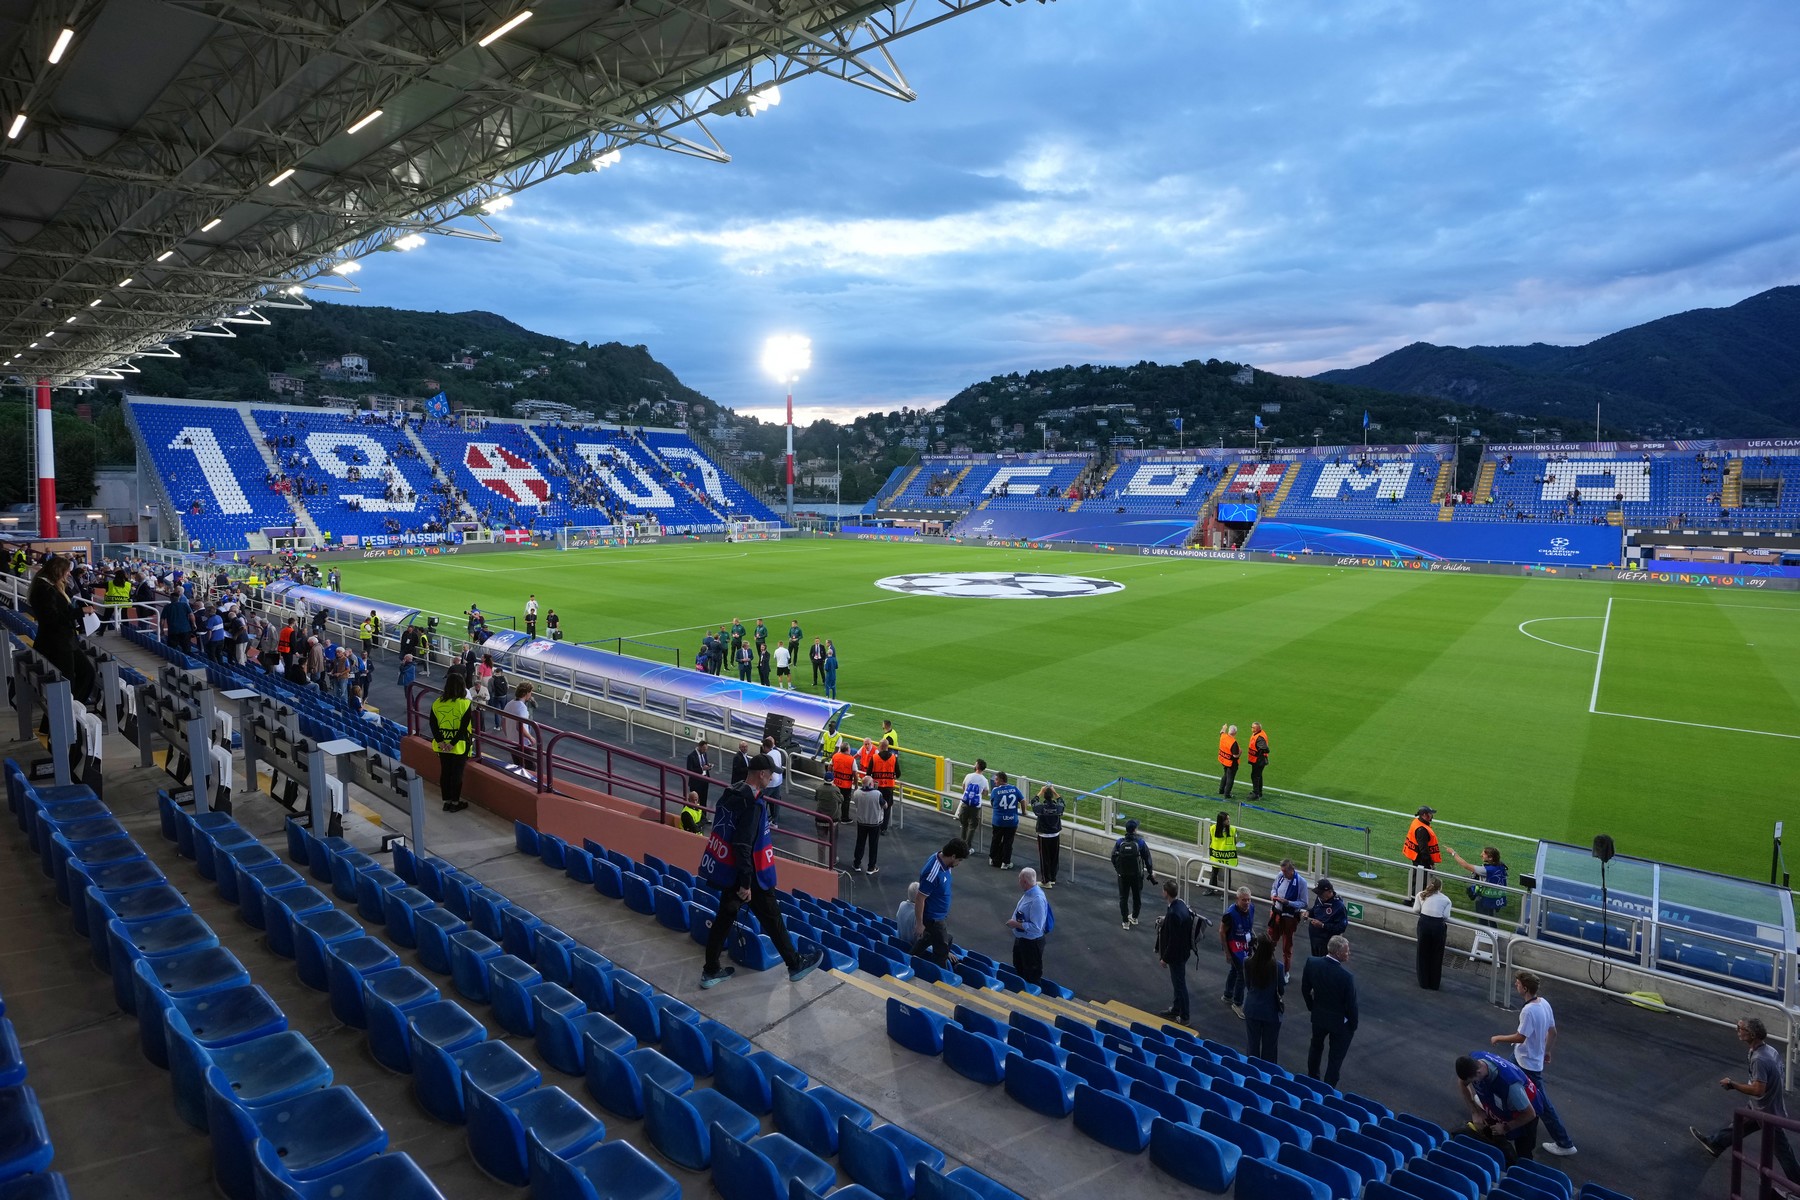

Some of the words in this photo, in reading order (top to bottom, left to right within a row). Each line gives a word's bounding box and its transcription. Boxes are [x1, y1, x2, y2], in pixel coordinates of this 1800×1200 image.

[363, 549, 386, 558] UEFA
[387, 547, 447, 557] FOUNDATION
[1152, 548, 1169, 556] UEFA
[1169, 549, 1208, 558] CHAMPIONS
[1337, 557, 1360, 566] UEFA
[1361, 558, 1429, 570] FOUNDATION
[1429, 562, 1442, 572] for
[1442, 562, 1471, 572] children
[1617, 571, 1648, 581] UEFA
[1651, 573, 1745, 587] FOUNDATION
[1746, 578, 1767, 587] .org
[999, 793, 1017, 810] 42
